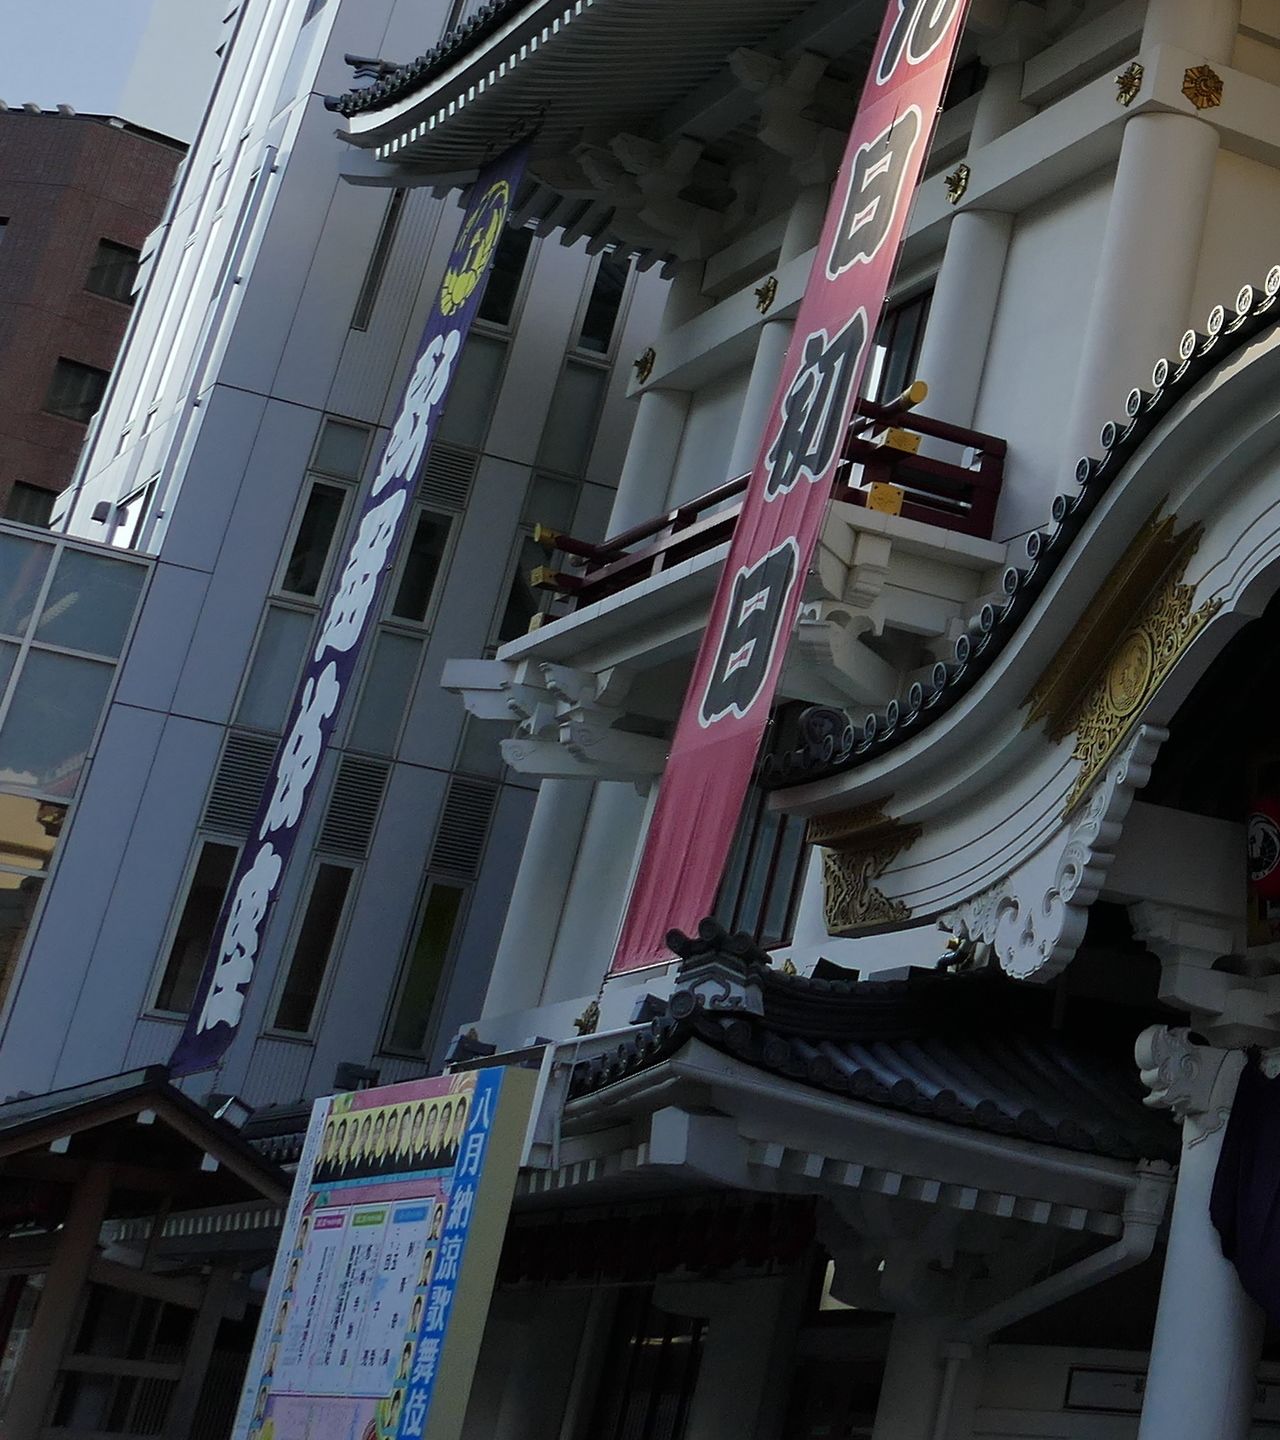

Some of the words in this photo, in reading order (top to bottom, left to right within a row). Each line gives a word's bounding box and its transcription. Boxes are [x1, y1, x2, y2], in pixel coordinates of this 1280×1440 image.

[197, 329, 461, 1034] 歌舞伎座
[401, 1084, 490, 1439] 八月納涼歌舞伎
